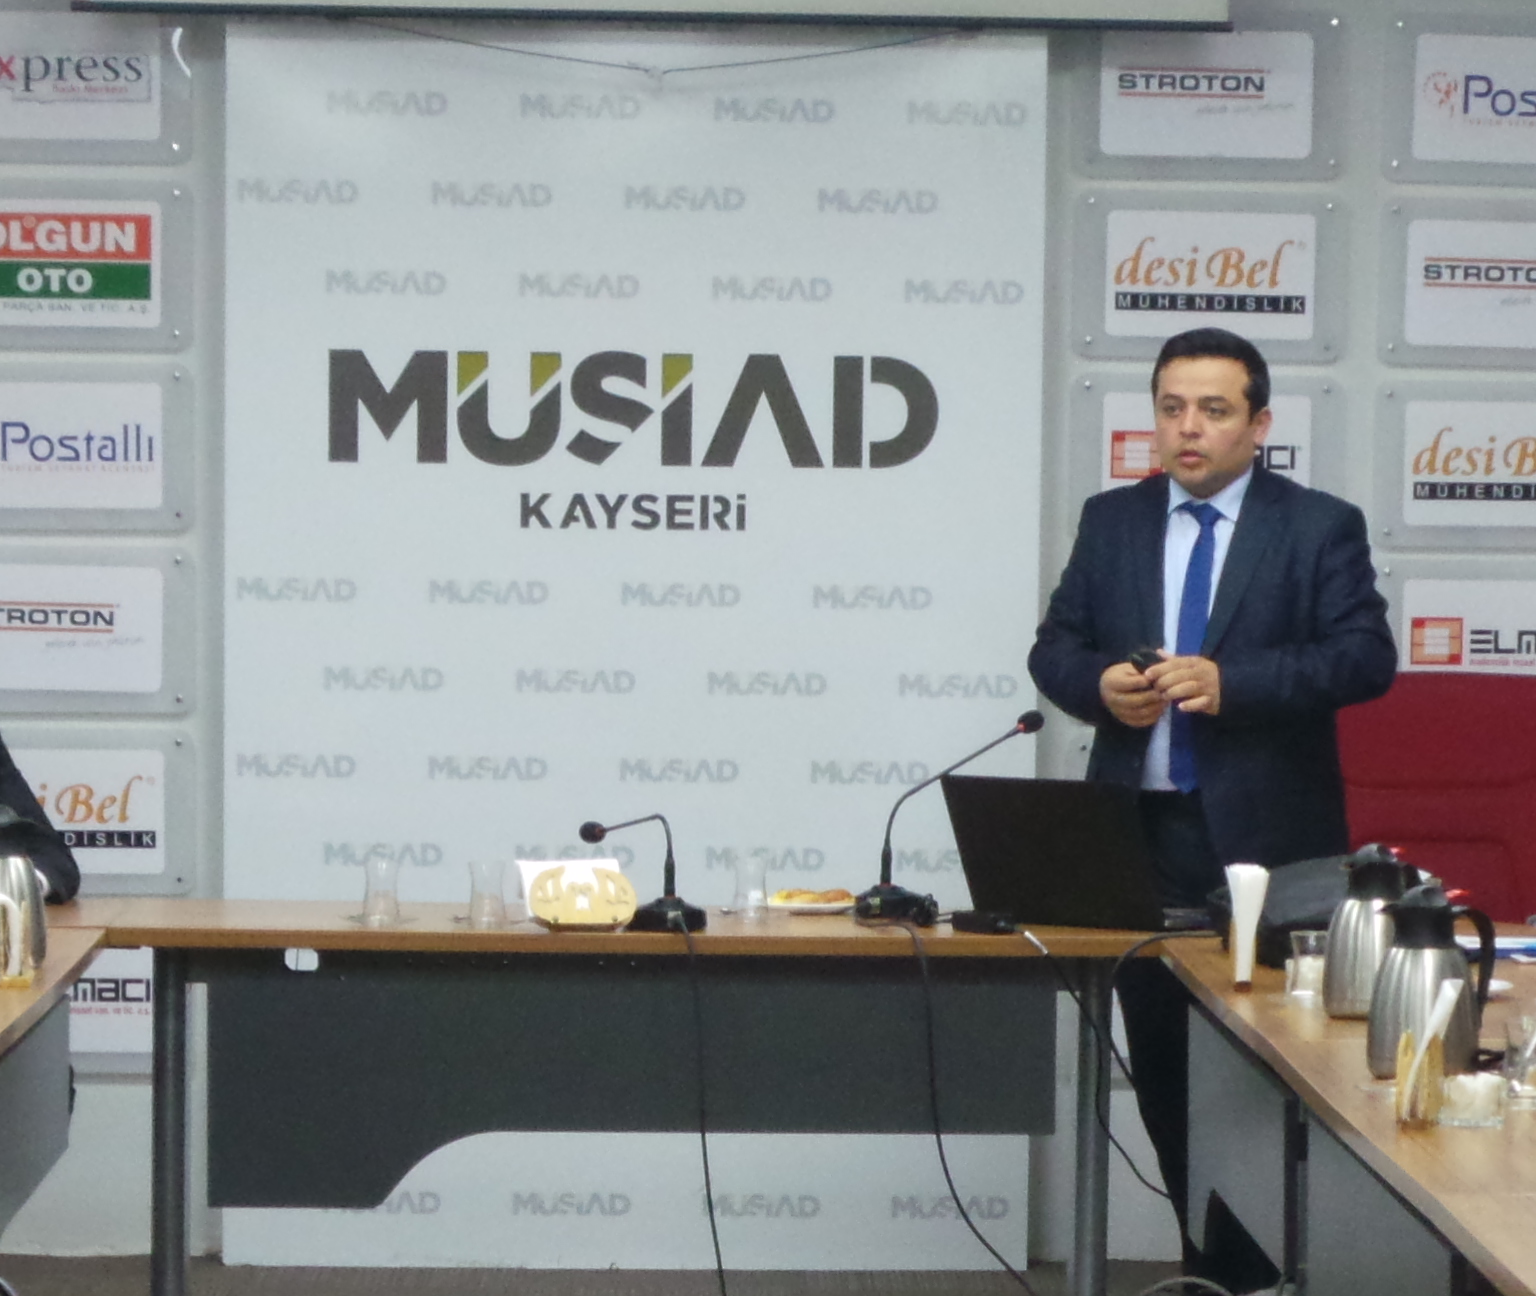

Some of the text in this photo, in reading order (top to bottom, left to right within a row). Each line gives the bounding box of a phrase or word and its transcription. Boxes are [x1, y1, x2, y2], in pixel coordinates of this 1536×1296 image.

[1119, 74, 1264, 92] STROTON
[17, 267, 93, 292] OTO
[64, 833, 153, 846] DİSLİK
[71, 978, 150, 1002] MACI
